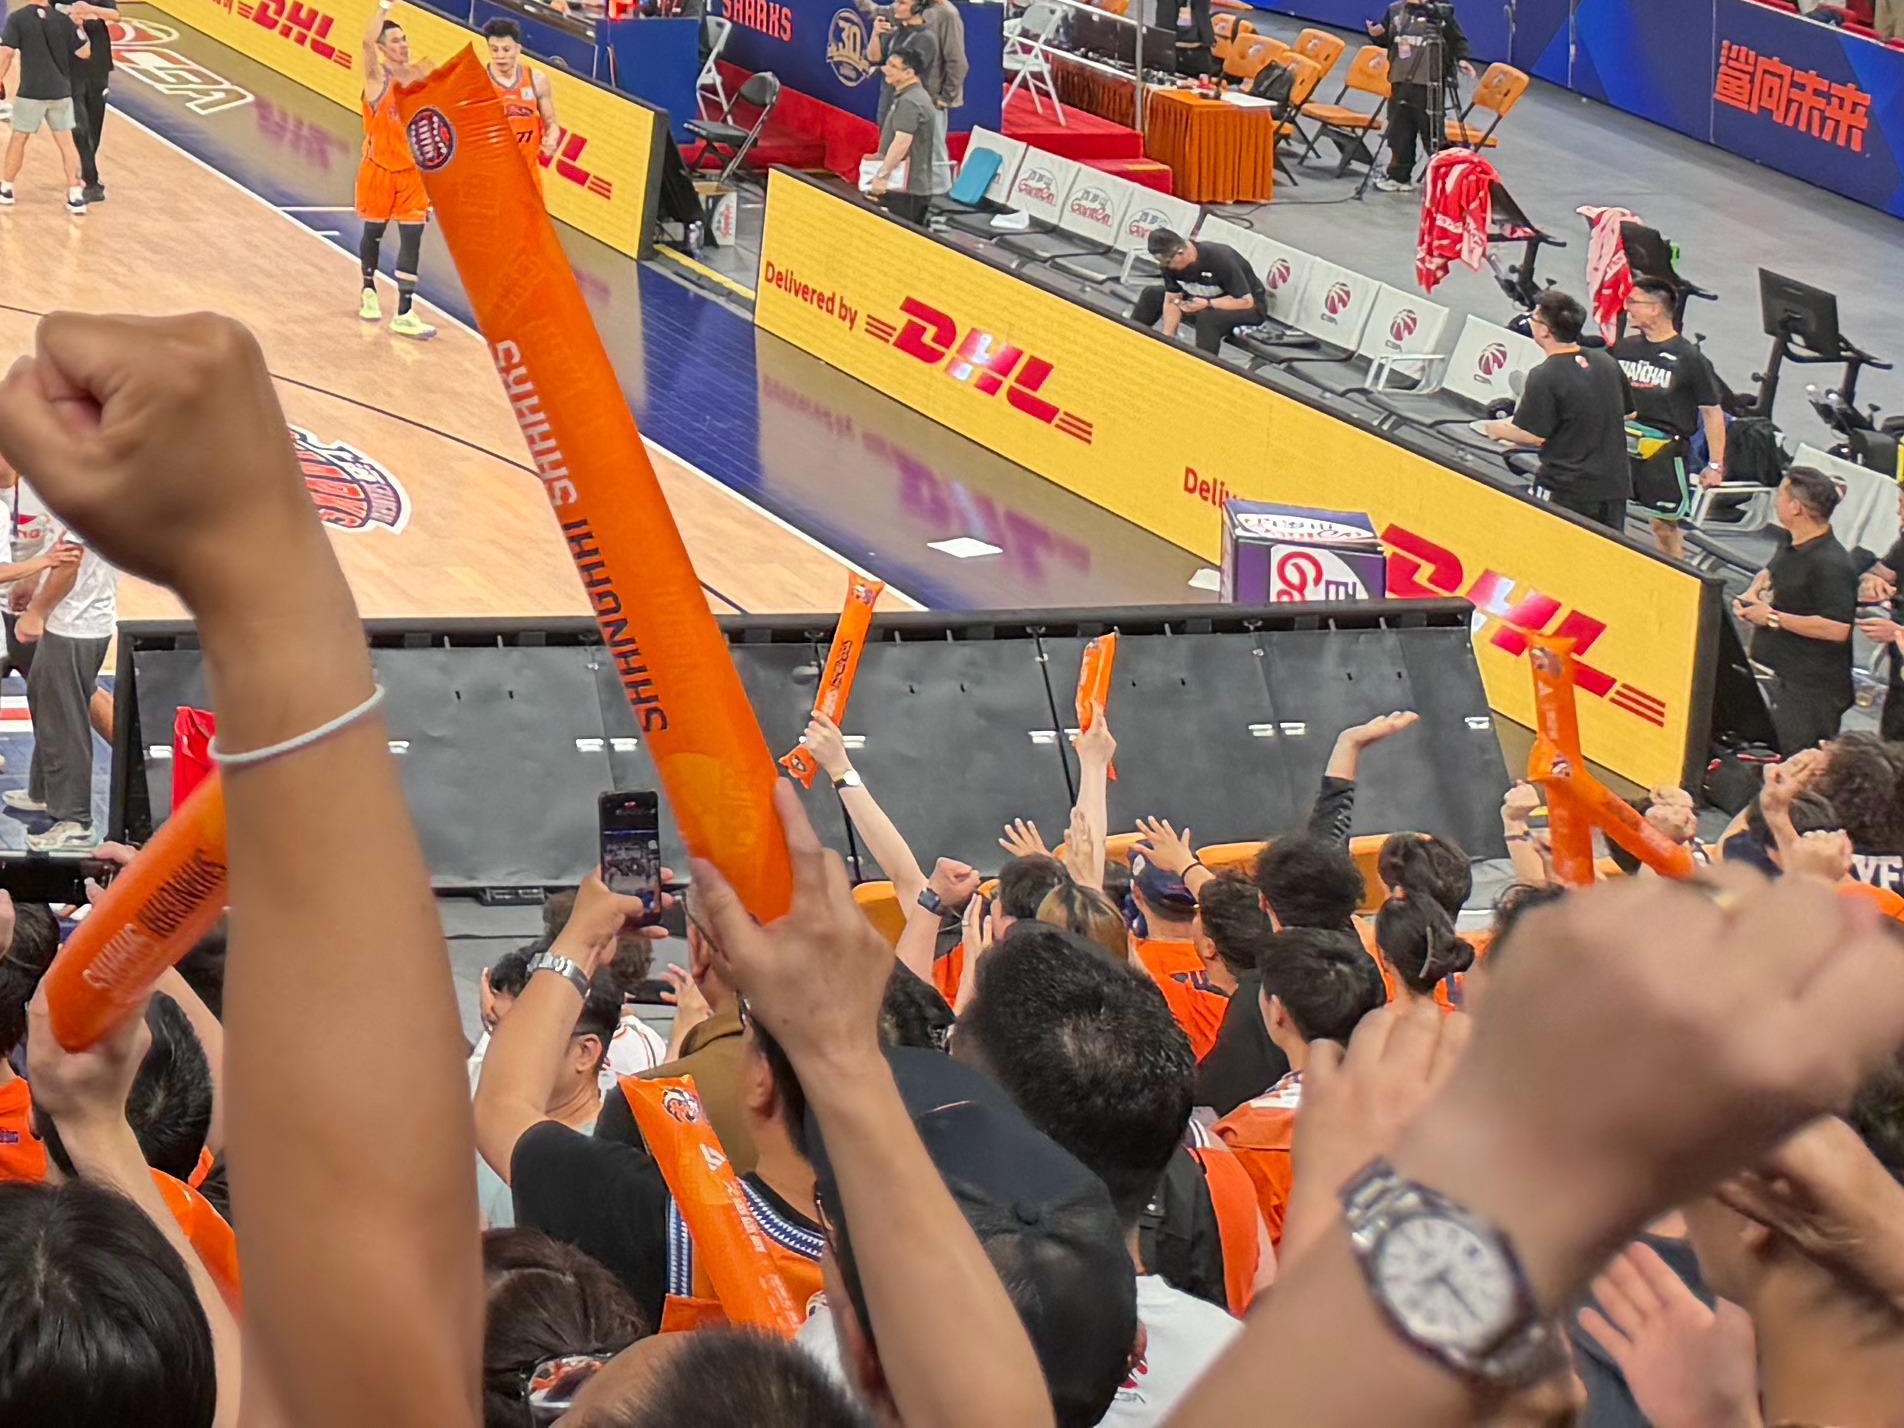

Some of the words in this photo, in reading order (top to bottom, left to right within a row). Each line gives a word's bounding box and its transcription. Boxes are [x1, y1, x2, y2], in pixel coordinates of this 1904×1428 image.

[1712, 39, 1873, 153] 鲨向未来
[494, 337, 580, 508] SHARKS
[763, 259, 835, 324] Delivered
[834, 297, 860, 333] by
[893, 296, 1061, 427] DHL
[567, 518, 671, 737] SHANGHAI
[1381, 522, 1618, 697] DHL
